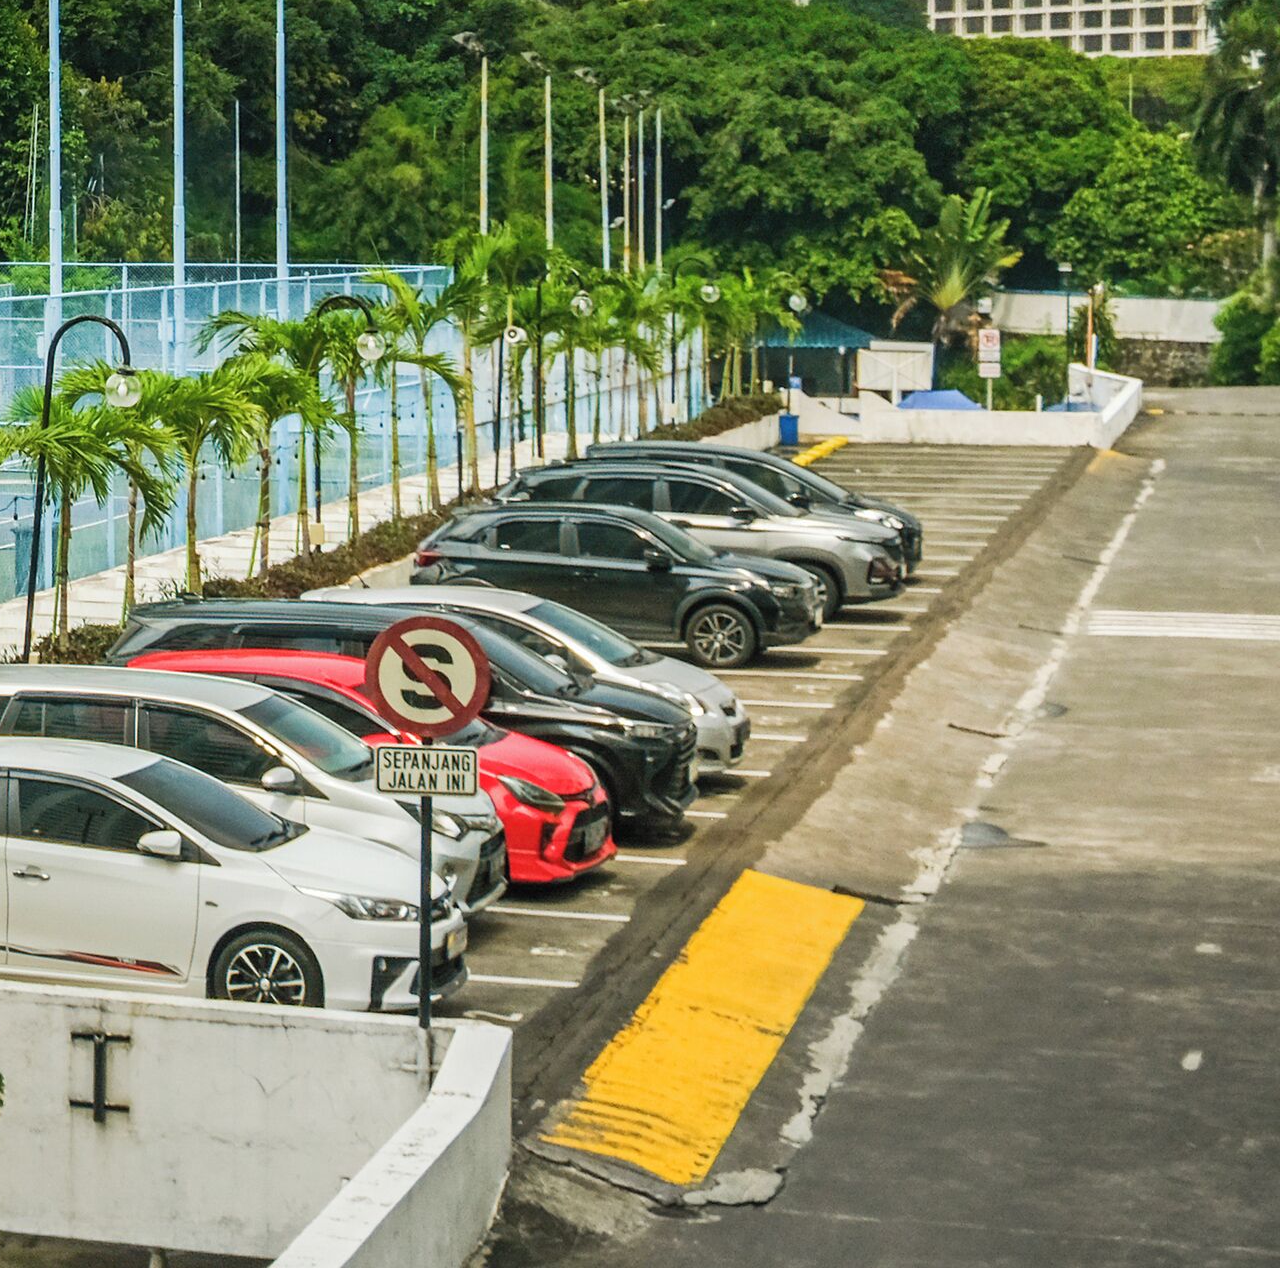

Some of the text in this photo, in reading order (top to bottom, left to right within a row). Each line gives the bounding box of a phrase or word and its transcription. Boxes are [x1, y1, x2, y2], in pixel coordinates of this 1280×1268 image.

[400, 643, 454, 709] S
[383, 750, 471, 772] SEPANJANG
[388, 771, 466, 791] JALAN INI
